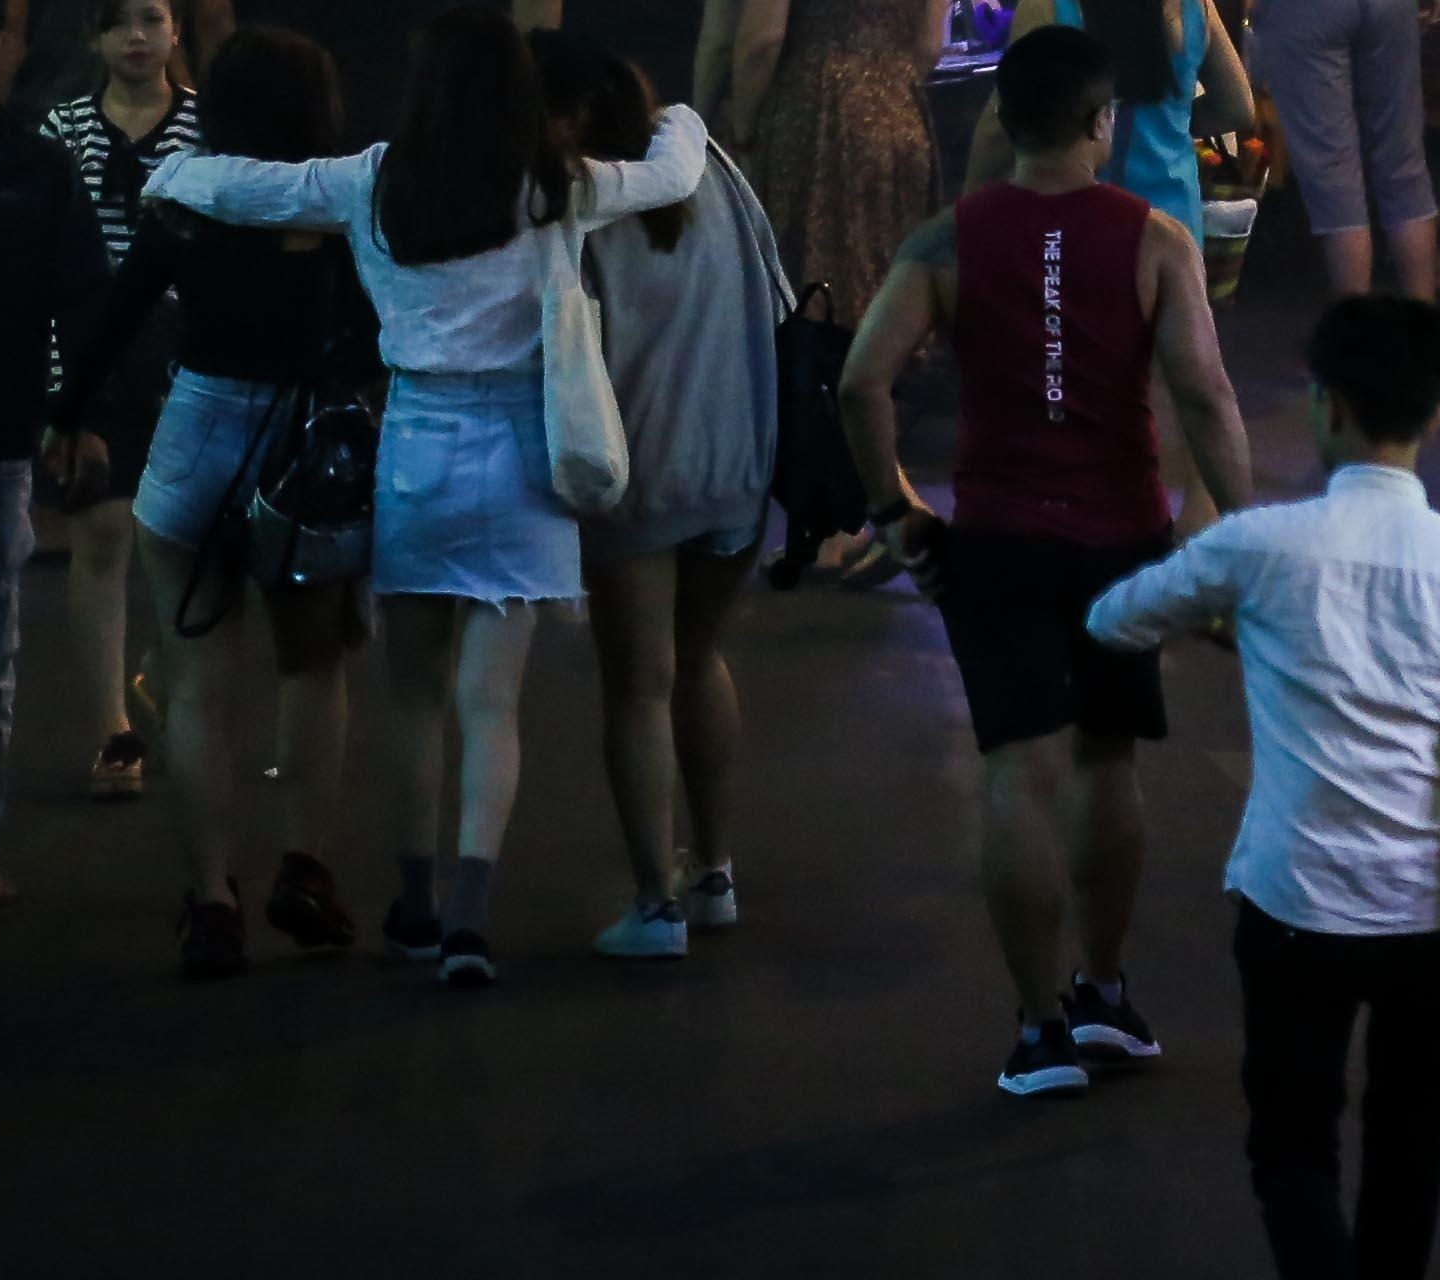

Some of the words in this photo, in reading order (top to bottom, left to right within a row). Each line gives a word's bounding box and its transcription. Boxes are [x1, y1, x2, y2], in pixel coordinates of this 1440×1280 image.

[1043, 229, 1062, 261] THE
[1043, 265, 1062, 311] PEAK
[1044, 313, 1062, 337] OF
